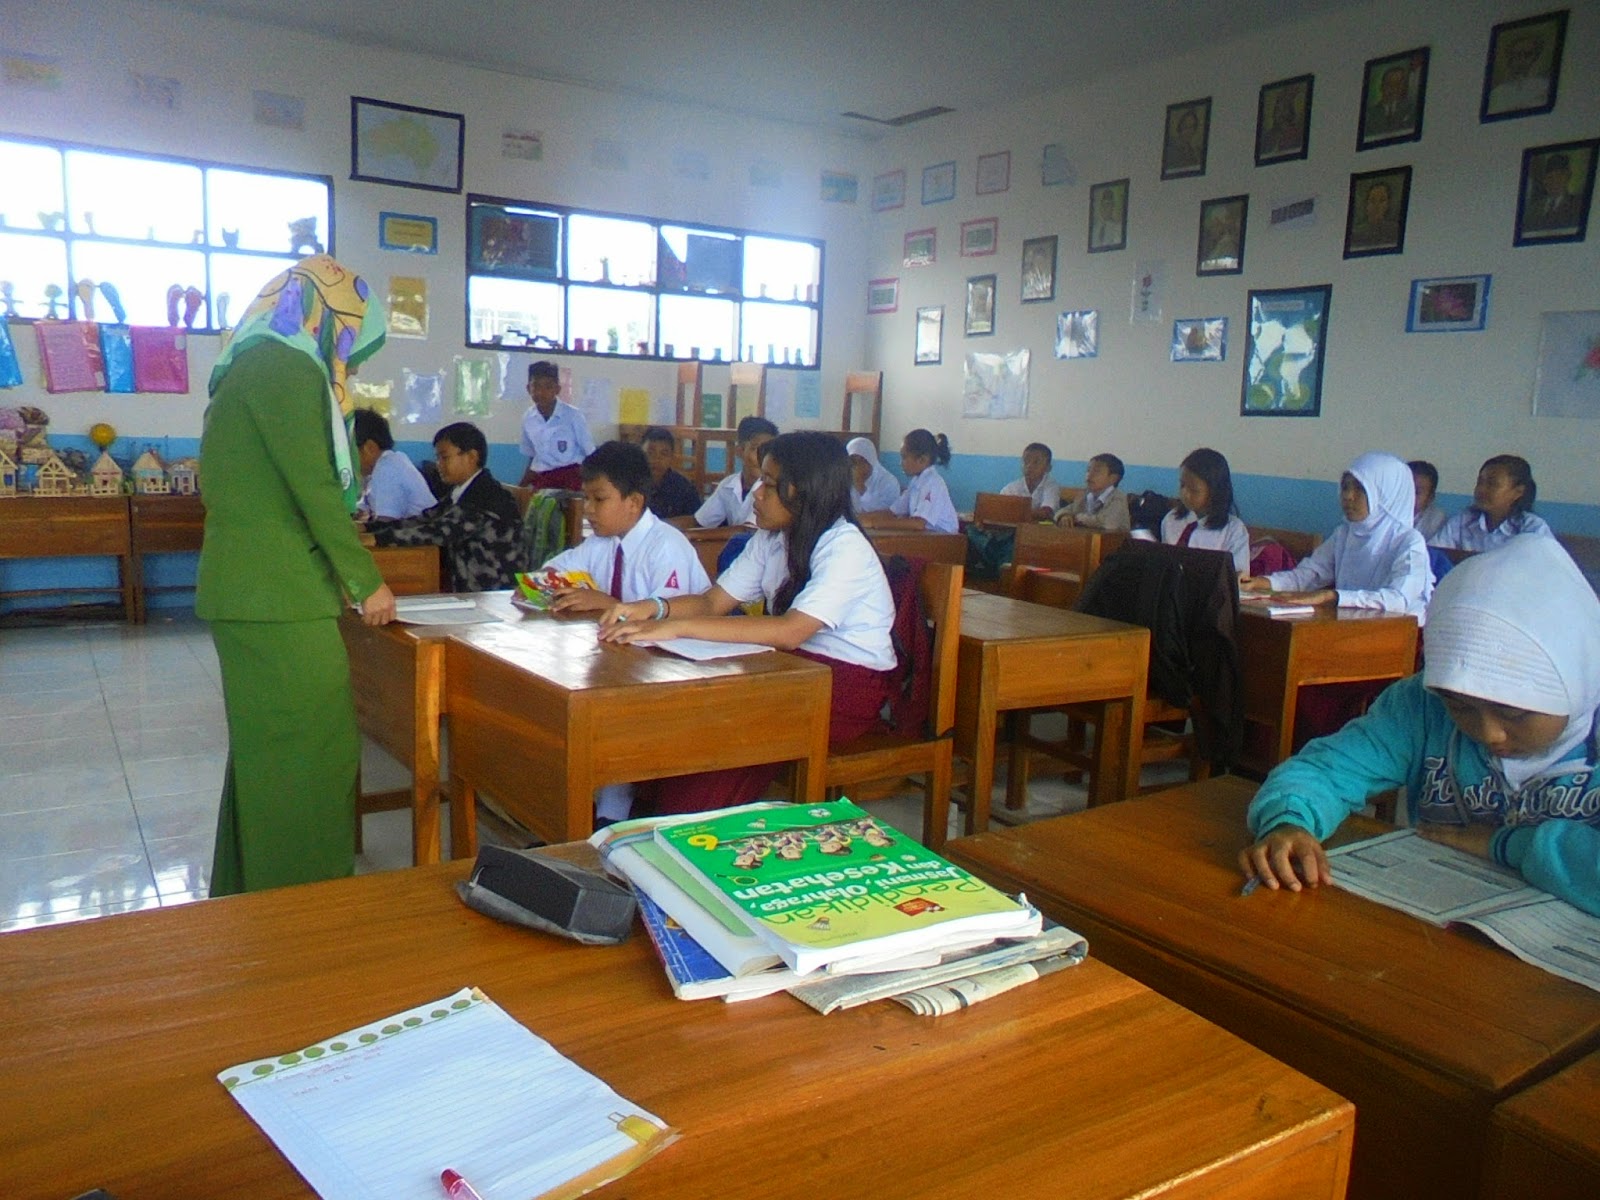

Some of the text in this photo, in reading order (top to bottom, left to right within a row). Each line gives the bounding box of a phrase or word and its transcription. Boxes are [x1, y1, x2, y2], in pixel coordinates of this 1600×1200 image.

[687, 833, 719, 851] 6
[733, 860, 941, 900] dan Kesehatan
[760, 877, 987, 925] Pendidikan
